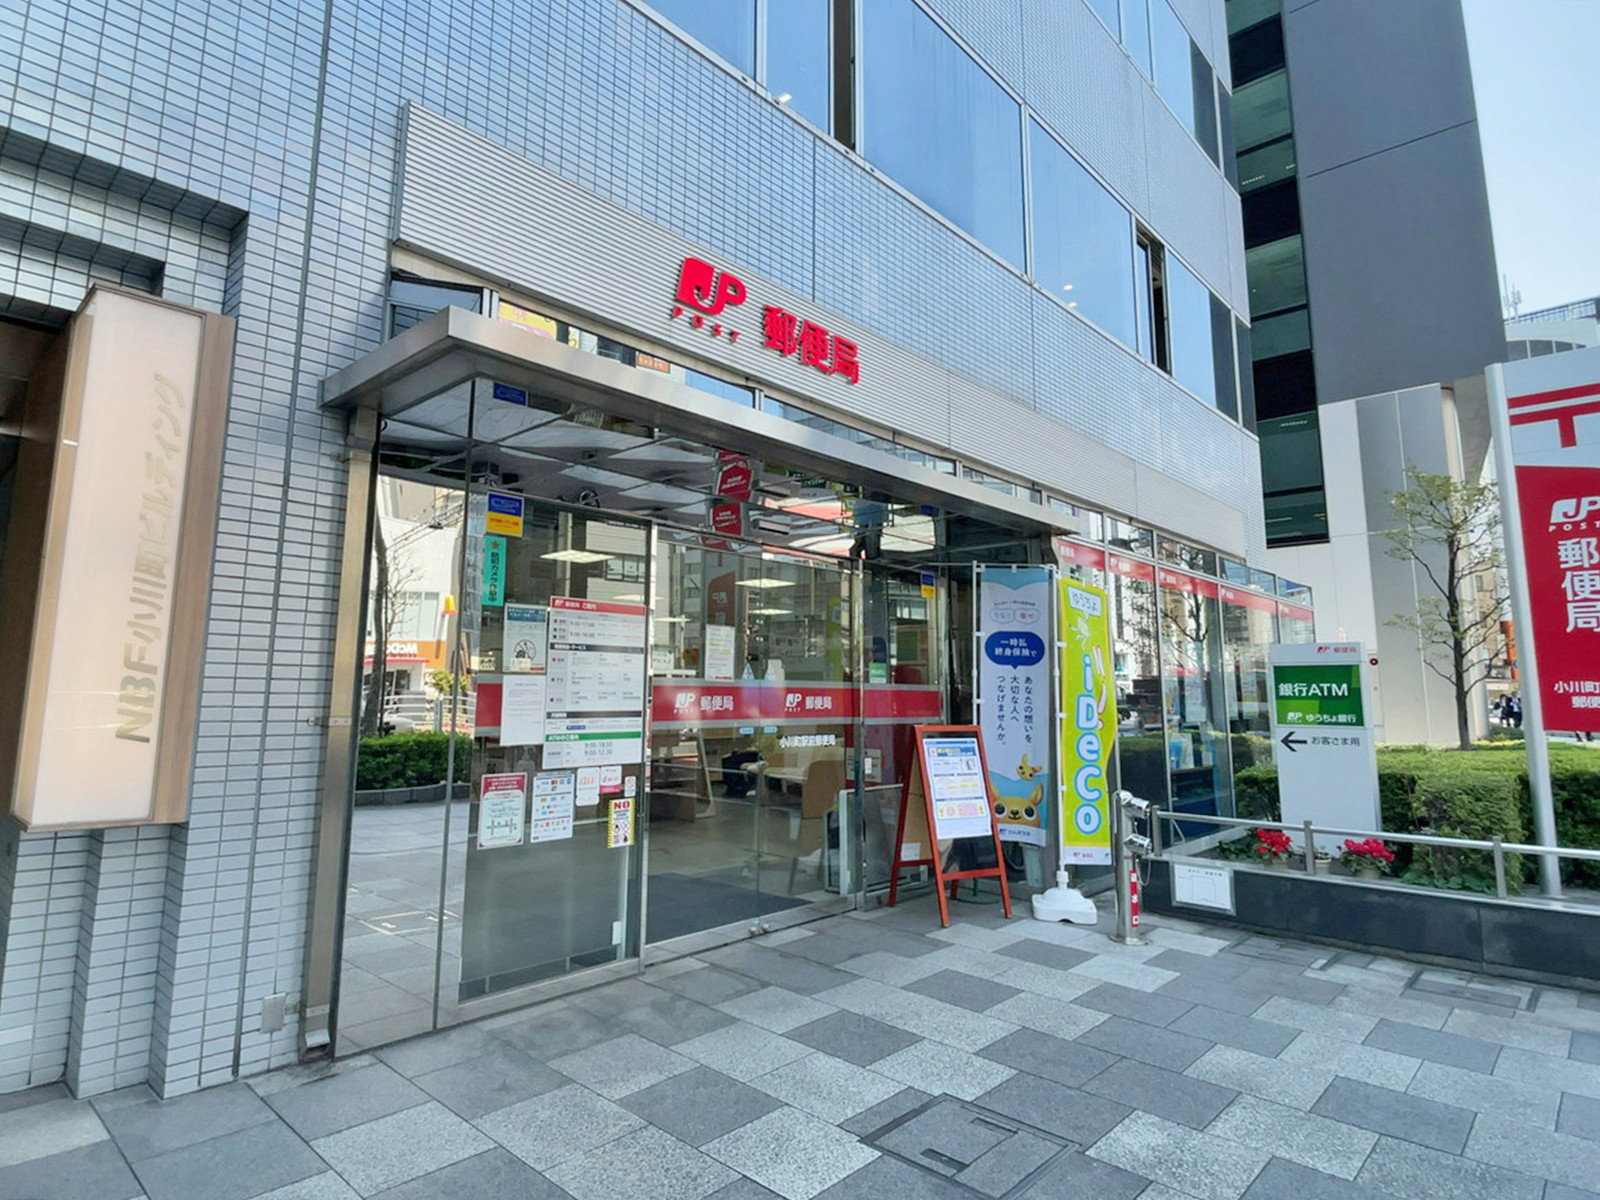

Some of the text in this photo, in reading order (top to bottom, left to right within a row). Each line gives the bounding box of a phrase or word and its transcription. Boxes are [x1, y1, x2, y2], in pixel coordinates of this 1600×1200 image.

[671, 305, 741, 344] POST
[764, 304, 860, 385] 郵便局
[115, 372, 185, 744] NBF小川町ビルディング
[1557, 536, 1600, 632] 郵便局
[995, 646, 1038, 658] 終身保険で
[1001, 638, 1028, 647] 一時払
[700, 695, 734, 710] 郵便局
[805, 696, 833, 709] 郵便局
[1010, 675, 1020, 722] 大切な人へ
[1278, 683, 1348, 696] 銀行ATM
[997, 675, 1006, 745] つなげませんか。
[1024, 676, 1034, 743] あなたの想いを
[1305, 714, 1357, 723] ゆうちょ銀行
[1075, 653, 1102, 836] iDeCo
[1311, 736, 1360, 746] お客さま用
[613, 801, 630, 809] NO
